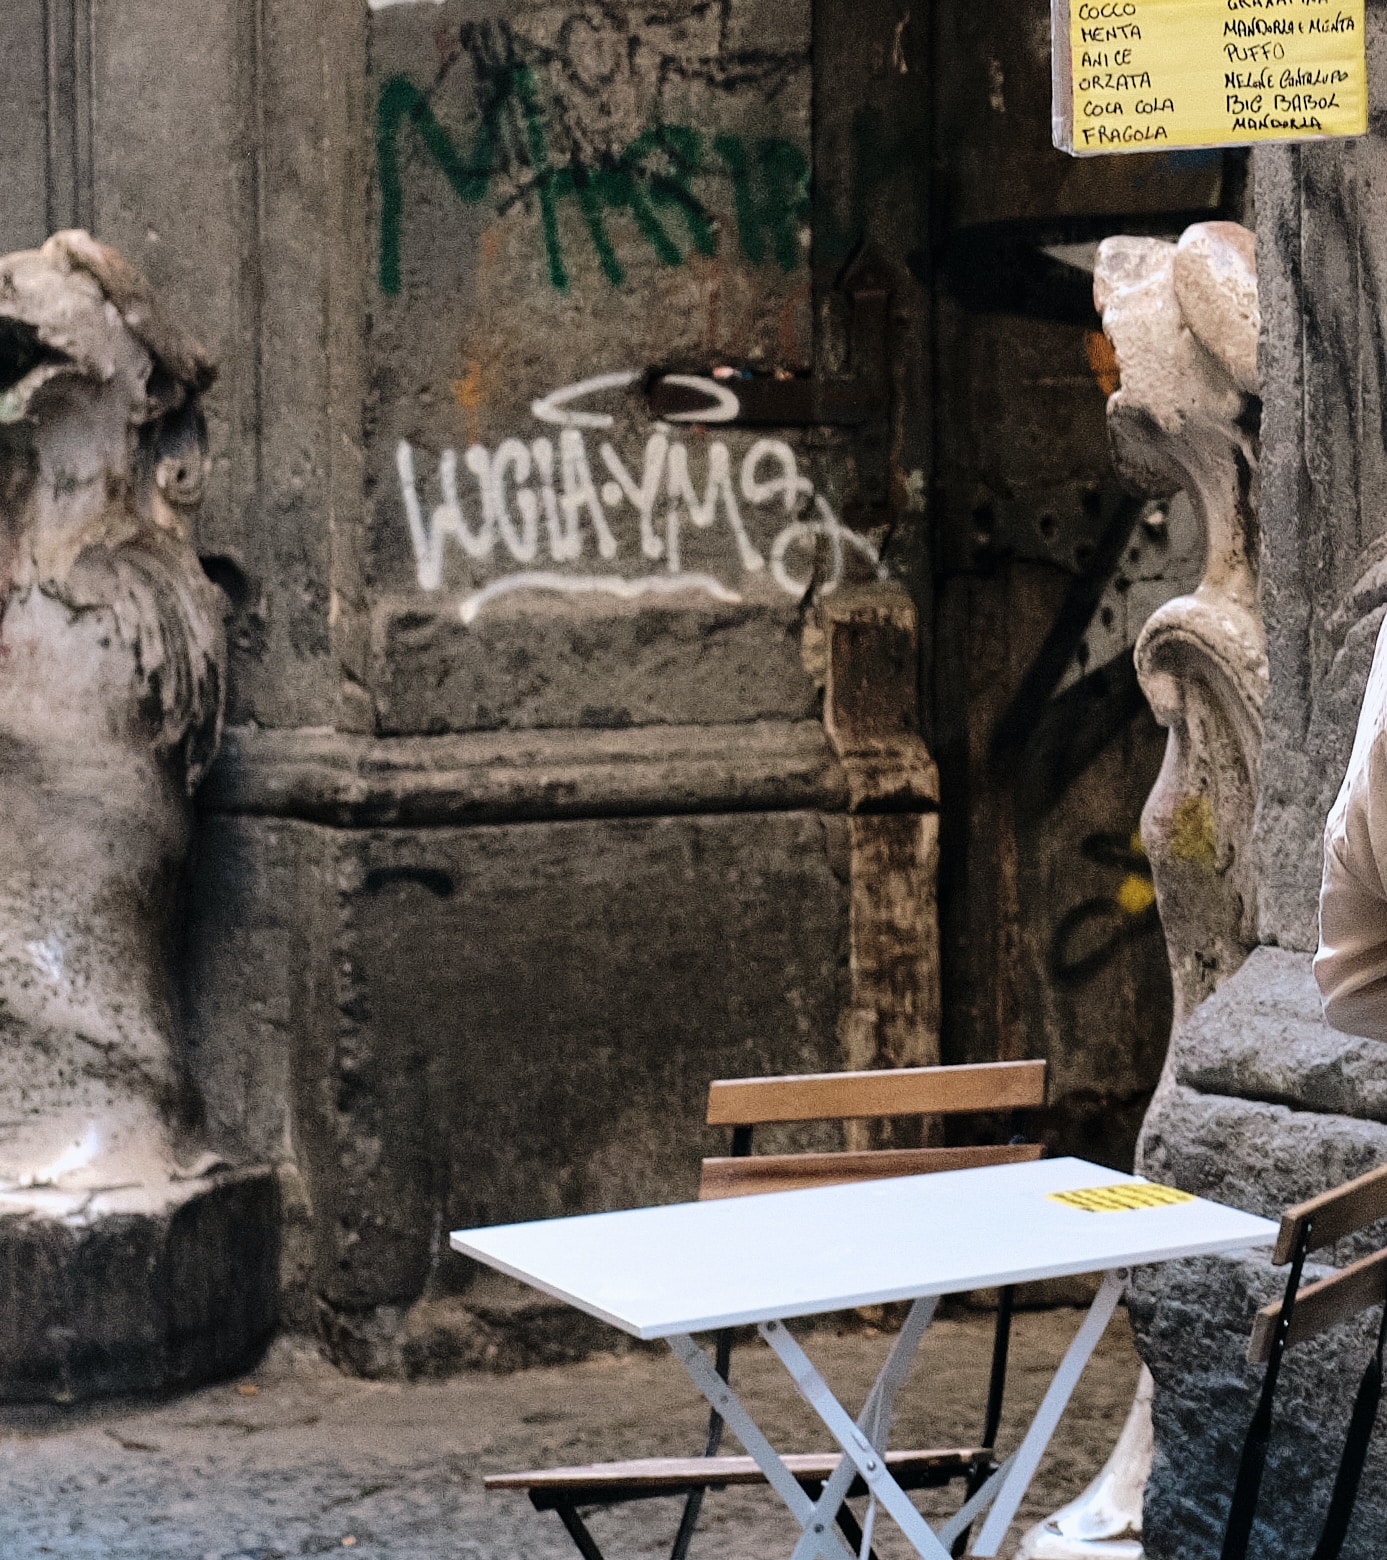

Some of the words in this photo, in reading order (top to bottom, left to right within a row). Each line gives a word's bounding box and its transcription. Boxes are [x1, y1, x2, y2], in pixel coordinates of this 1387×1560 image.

[1078, 2, 1137, 21] COCCO
[1080, 22, 1142, 43] MENTA
[1223, 16, 1294, 38] MANDORLA
[1308, 10, 1355, 34] MENTA
[1081, 48, 1132, 68] ANICE
[1223, 40, 1285, 63] PUFFO
[1078, 71, 1152, 91] ORZATA
[1083, 100, 1124, 117] COCA
[1135, 97, 1175, 114] COLA
[1274, 92, 1340, 113] BABOL
[1232, 112, 1322, 133] MANDORLA
[1082, 124, 1168, 145] FRAGOLA
